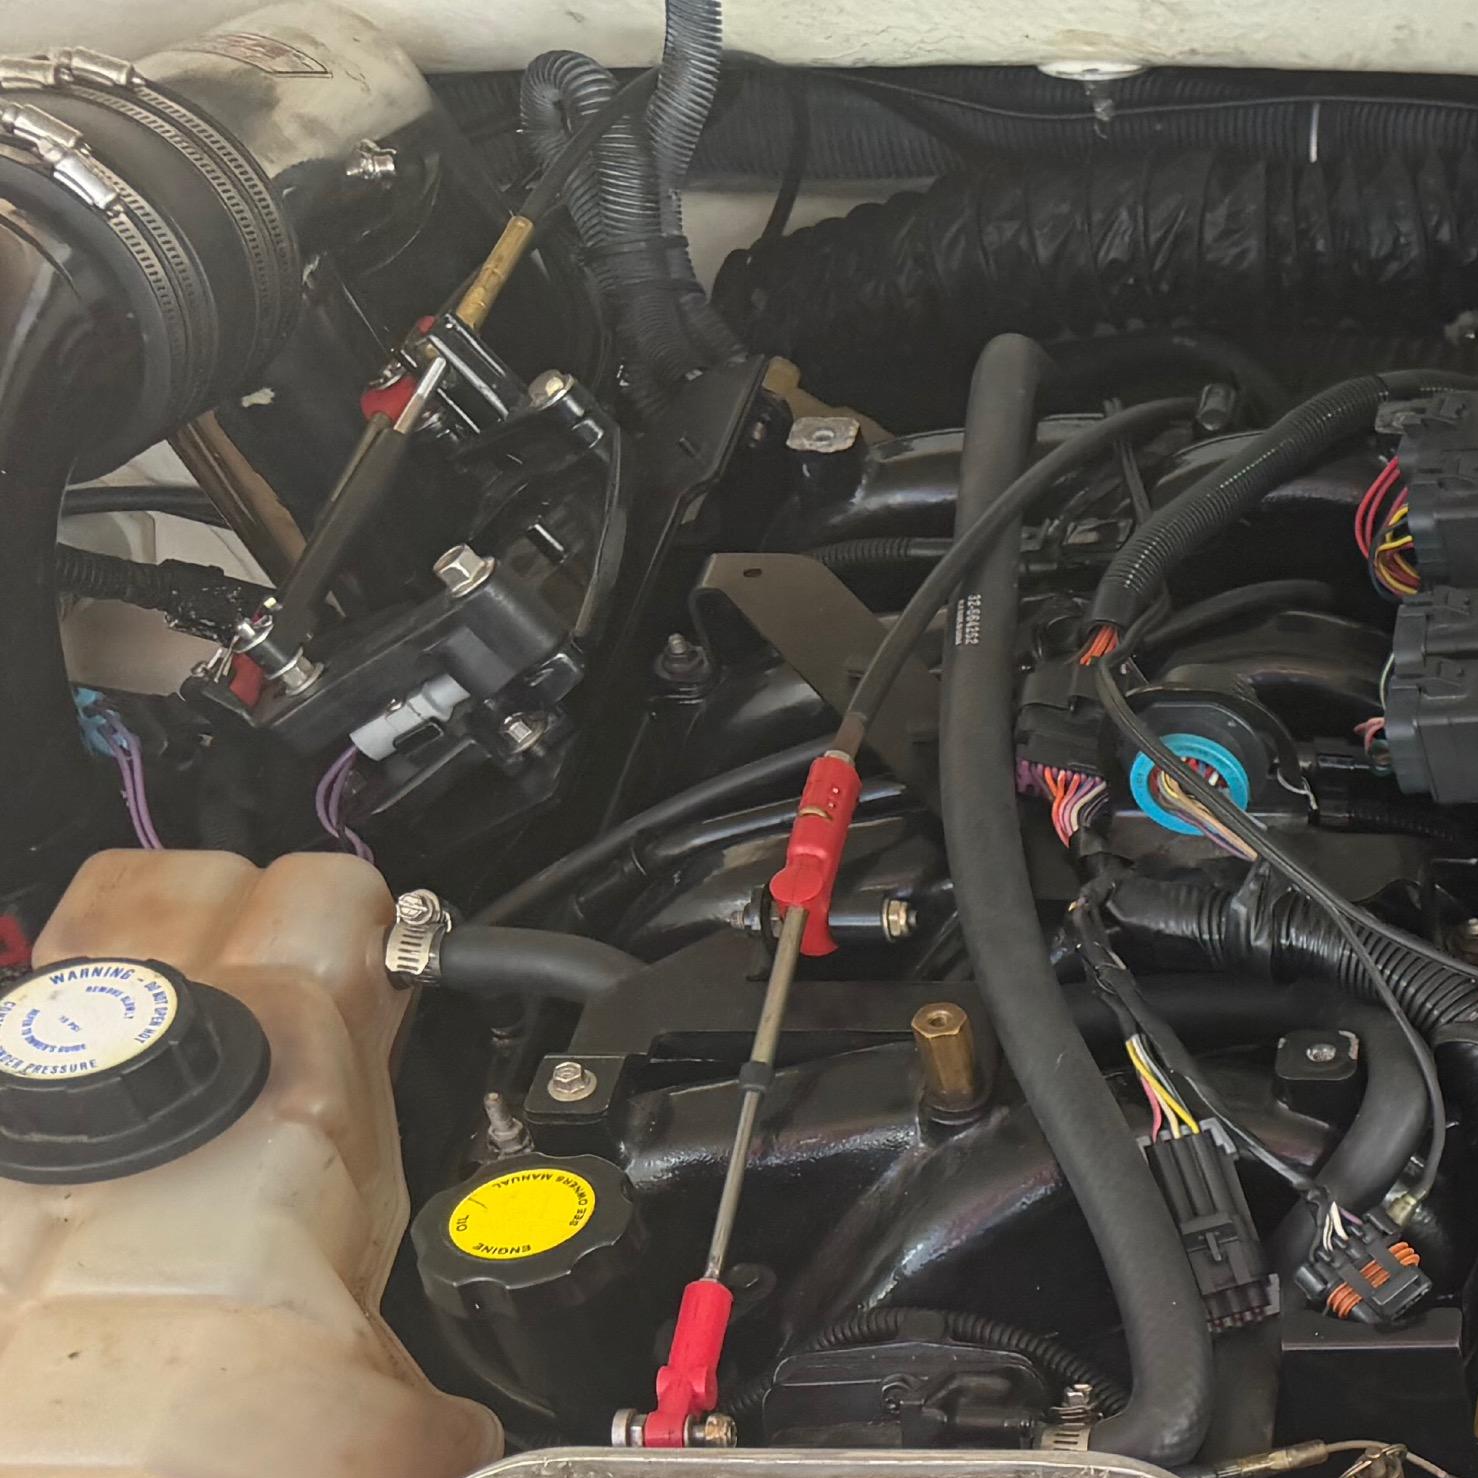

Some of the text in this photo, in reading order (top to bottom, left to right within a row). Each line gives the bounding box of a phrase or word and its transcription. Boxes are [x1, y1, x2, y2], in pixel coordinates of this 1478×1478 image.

[50, 967, 135, 985] WARNING
[25, 1059, 97, 1074] PRESSURE
[492, 1174, 588, 1226] SEE OWNERS MANUAL
[456, 1215, 531, 1254] ENGINE OIL
